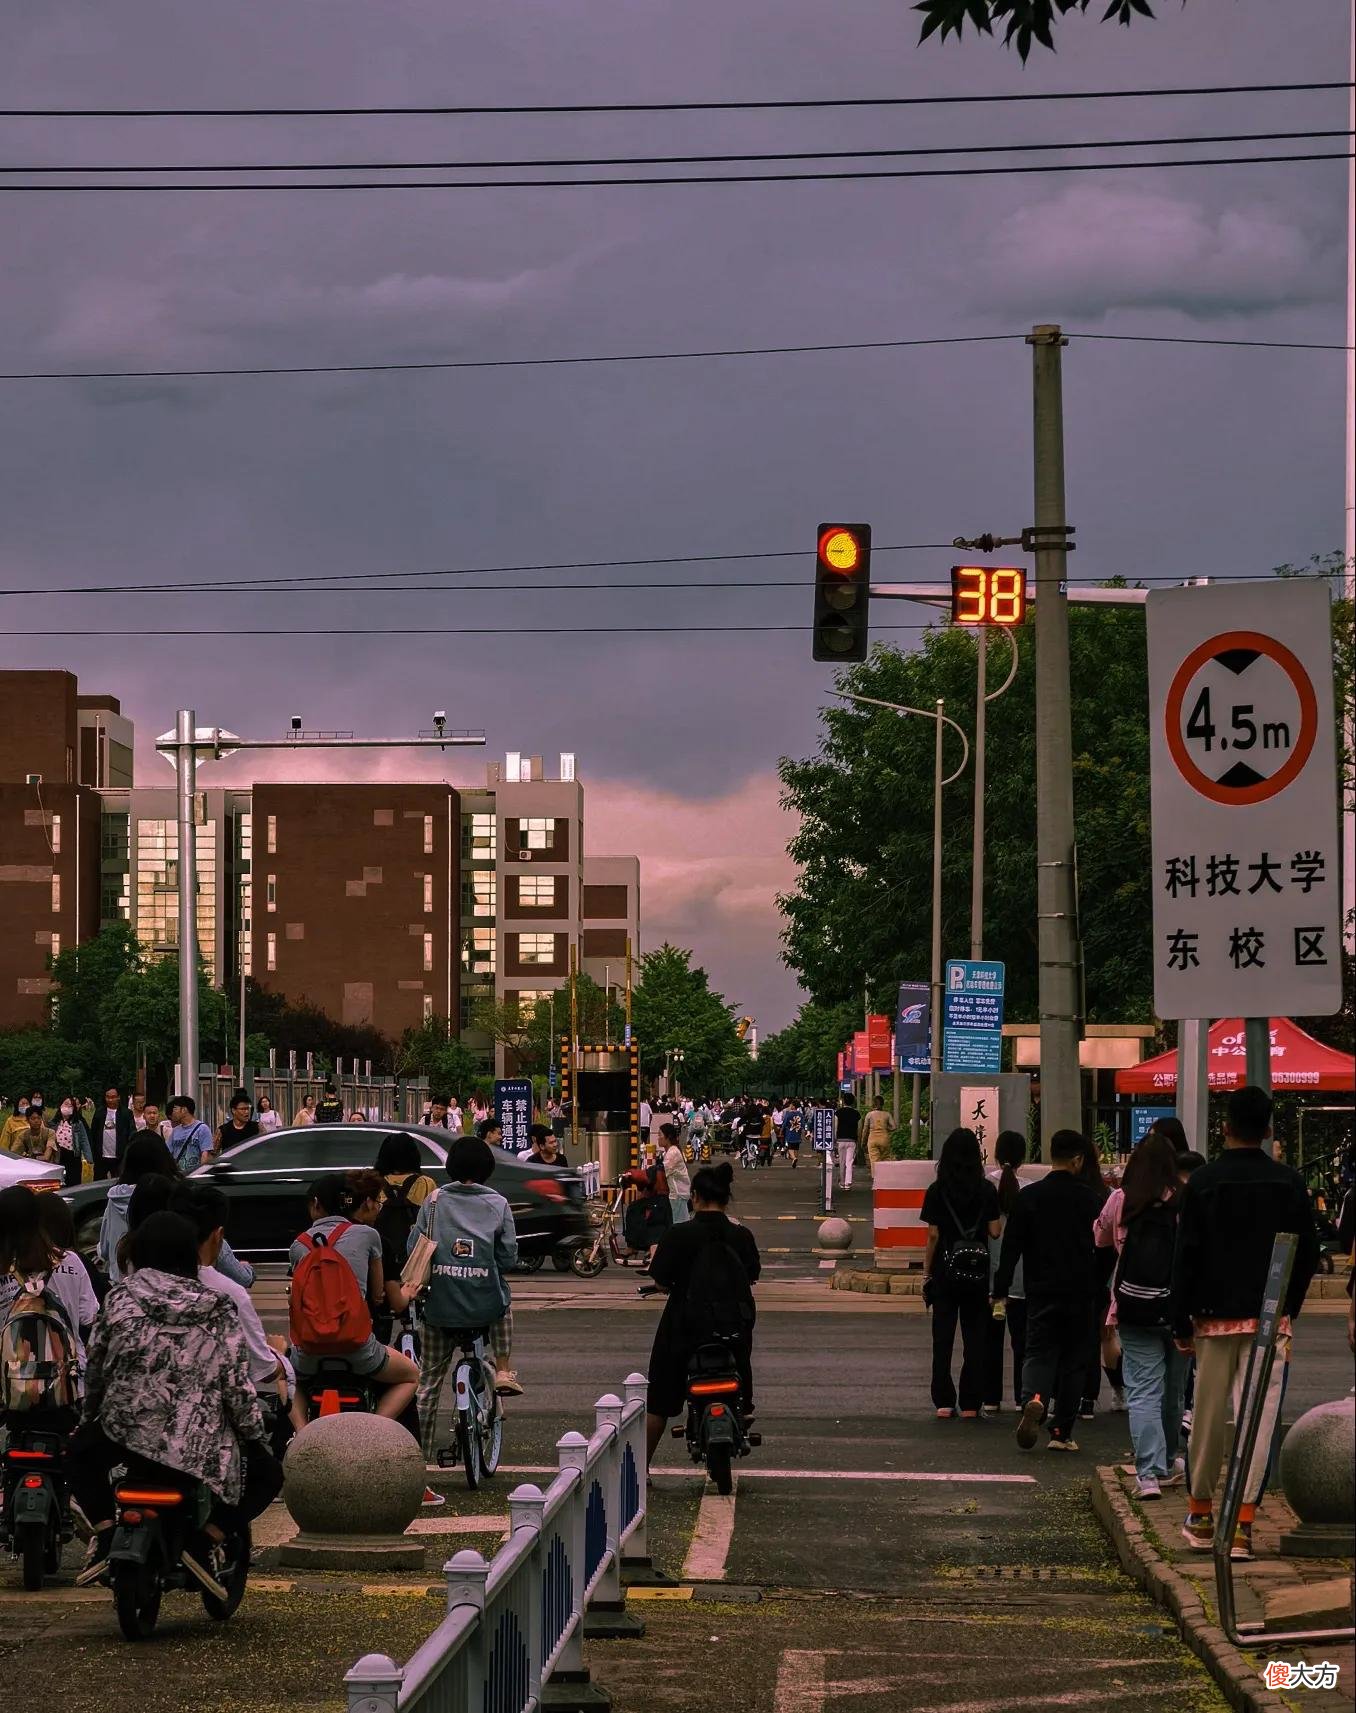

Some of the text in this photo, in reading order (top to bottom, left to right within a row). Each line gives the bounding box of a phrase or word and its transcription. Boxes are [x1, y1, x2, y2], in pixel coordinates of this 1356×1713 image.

[959, 568, 1021, 622] 38
[1187, 686, 1290, 752] 4.5m
[1165, 850, 1326, 899] 科技大学
[1166, 926, 1328, 971] 东校区
[501, 1099, 514, 1150] 车辆通行
[515, 1099, 528, 1149] 禁止机动
